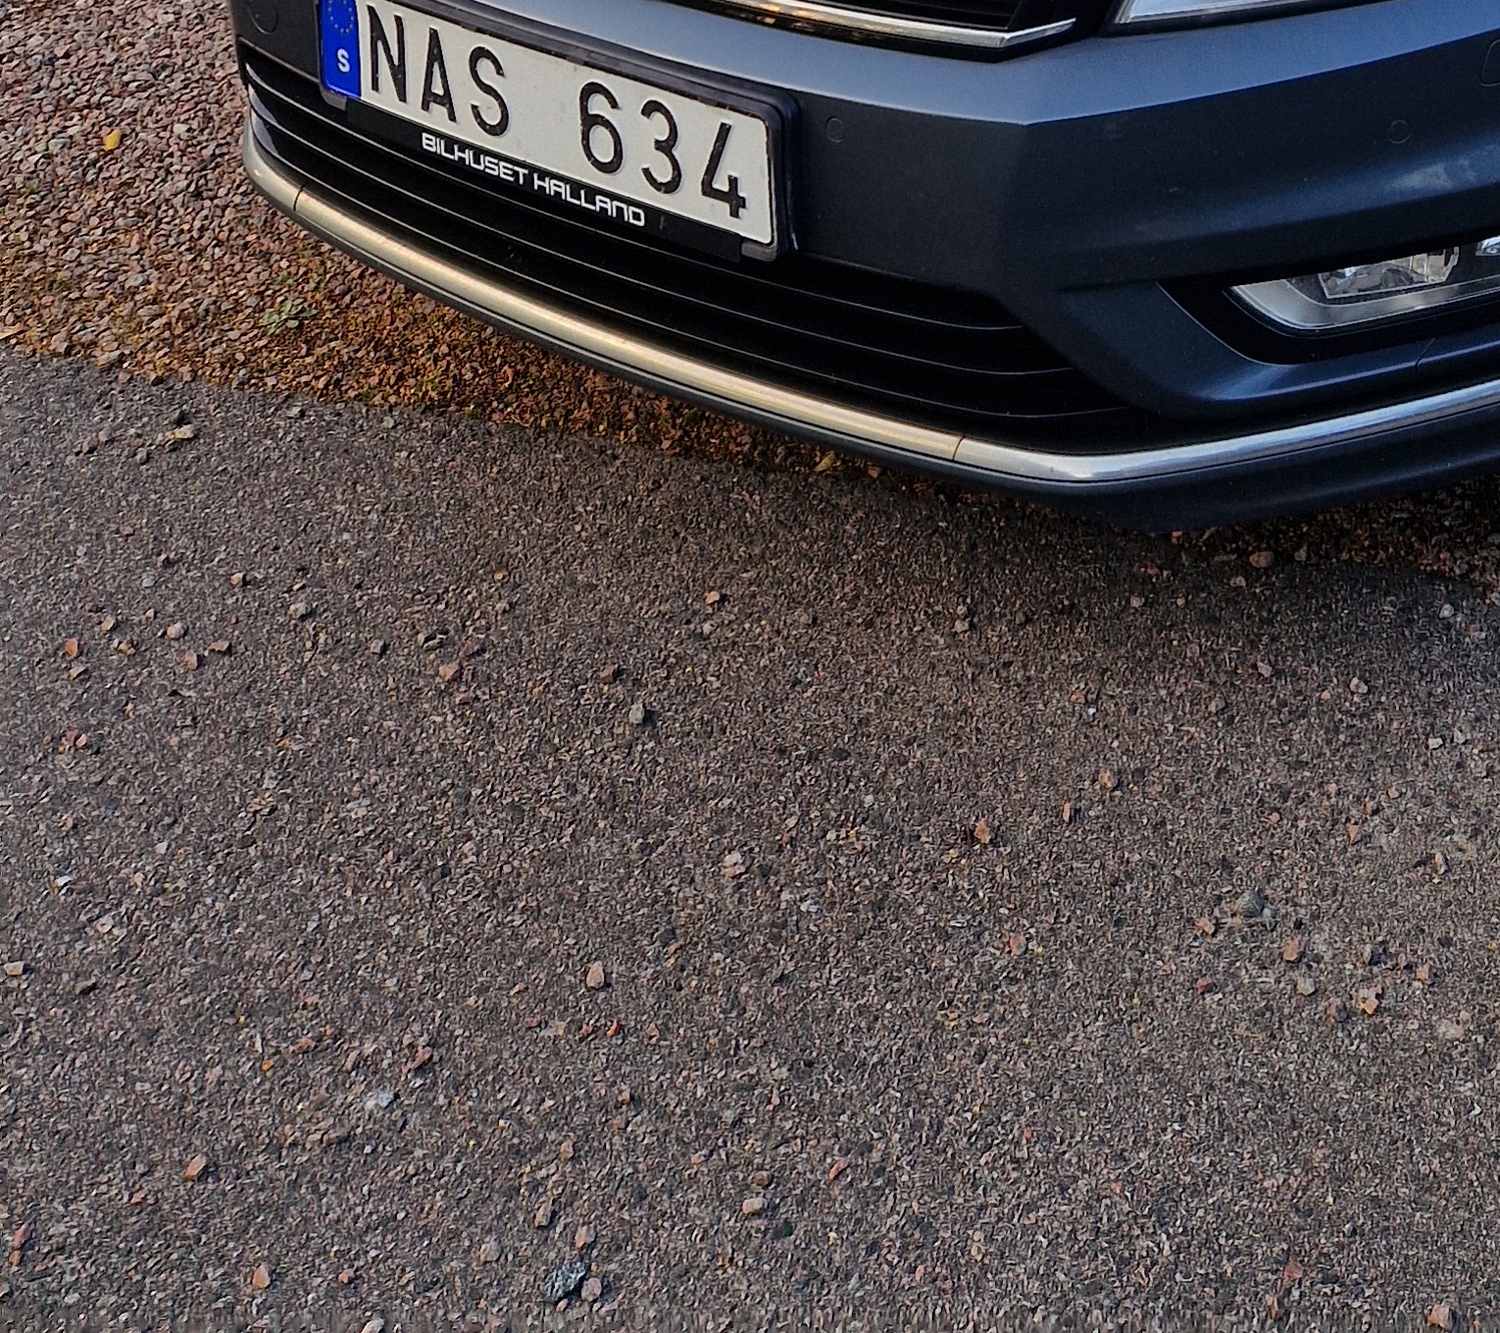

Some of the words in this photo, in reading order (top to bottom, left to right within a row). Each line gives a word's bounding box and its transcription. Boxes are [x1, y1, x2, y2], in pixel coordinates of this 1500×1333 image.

[336, 47, 351, 73] S
[366, 4, 510, 137] NAS
[578, 81, 748, 220] 634
[421, 132, 529, 185] BILHUSET
[533, 173, 646, 227] HALLAND
